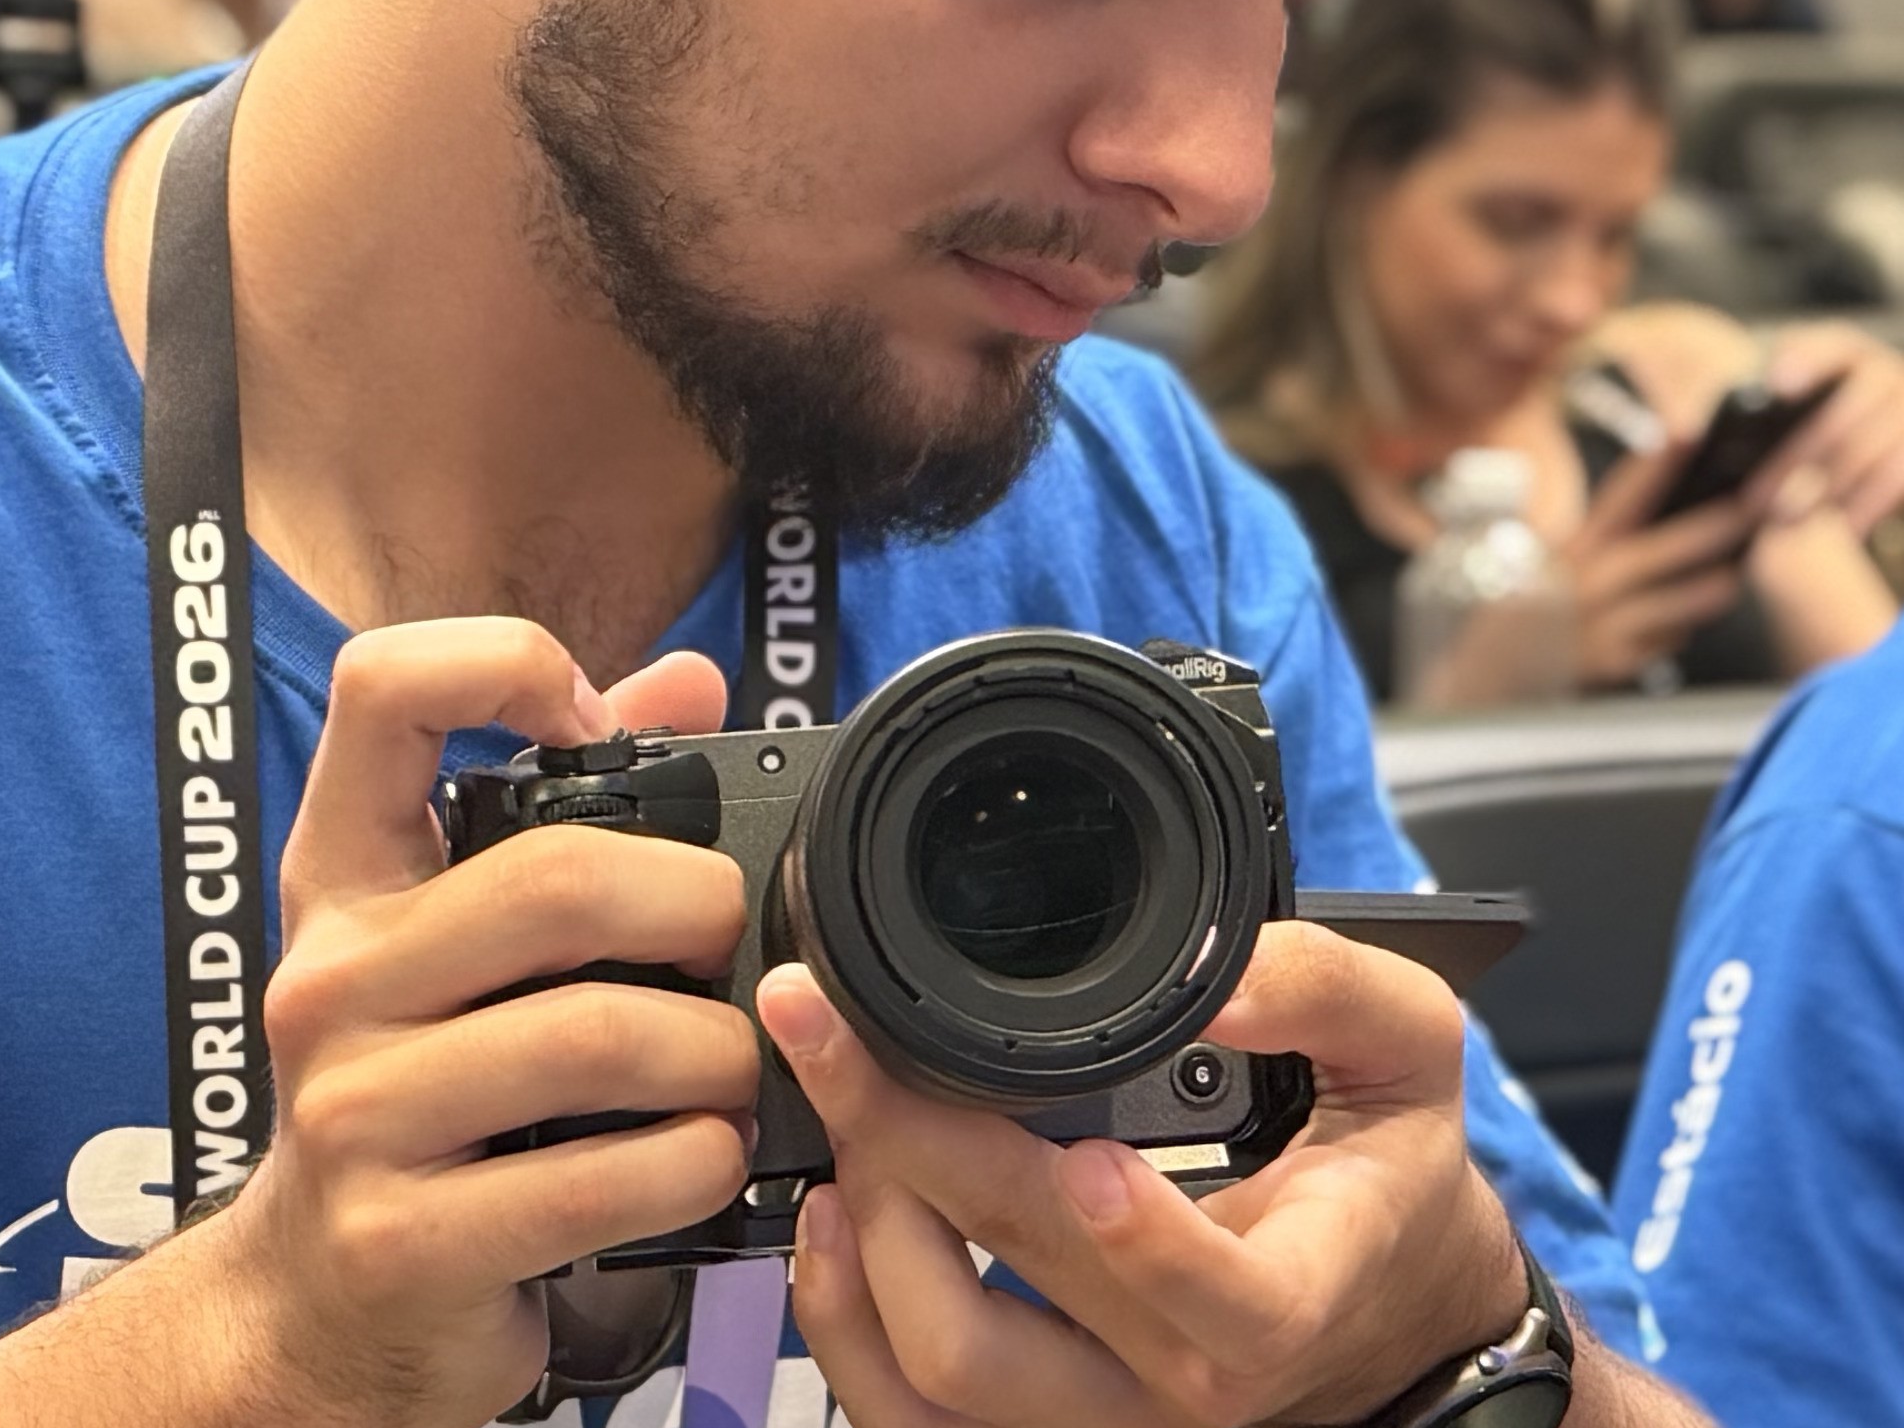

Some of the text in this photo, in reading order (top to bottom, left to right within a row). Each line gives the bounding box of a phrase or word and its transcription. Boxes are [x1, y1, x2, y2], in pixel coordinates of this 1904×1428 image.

[1162, 656, 1227, 684] allRig
[182, 776, 240, 917] CUP
[189, 932, 251, 1196] WORLD
